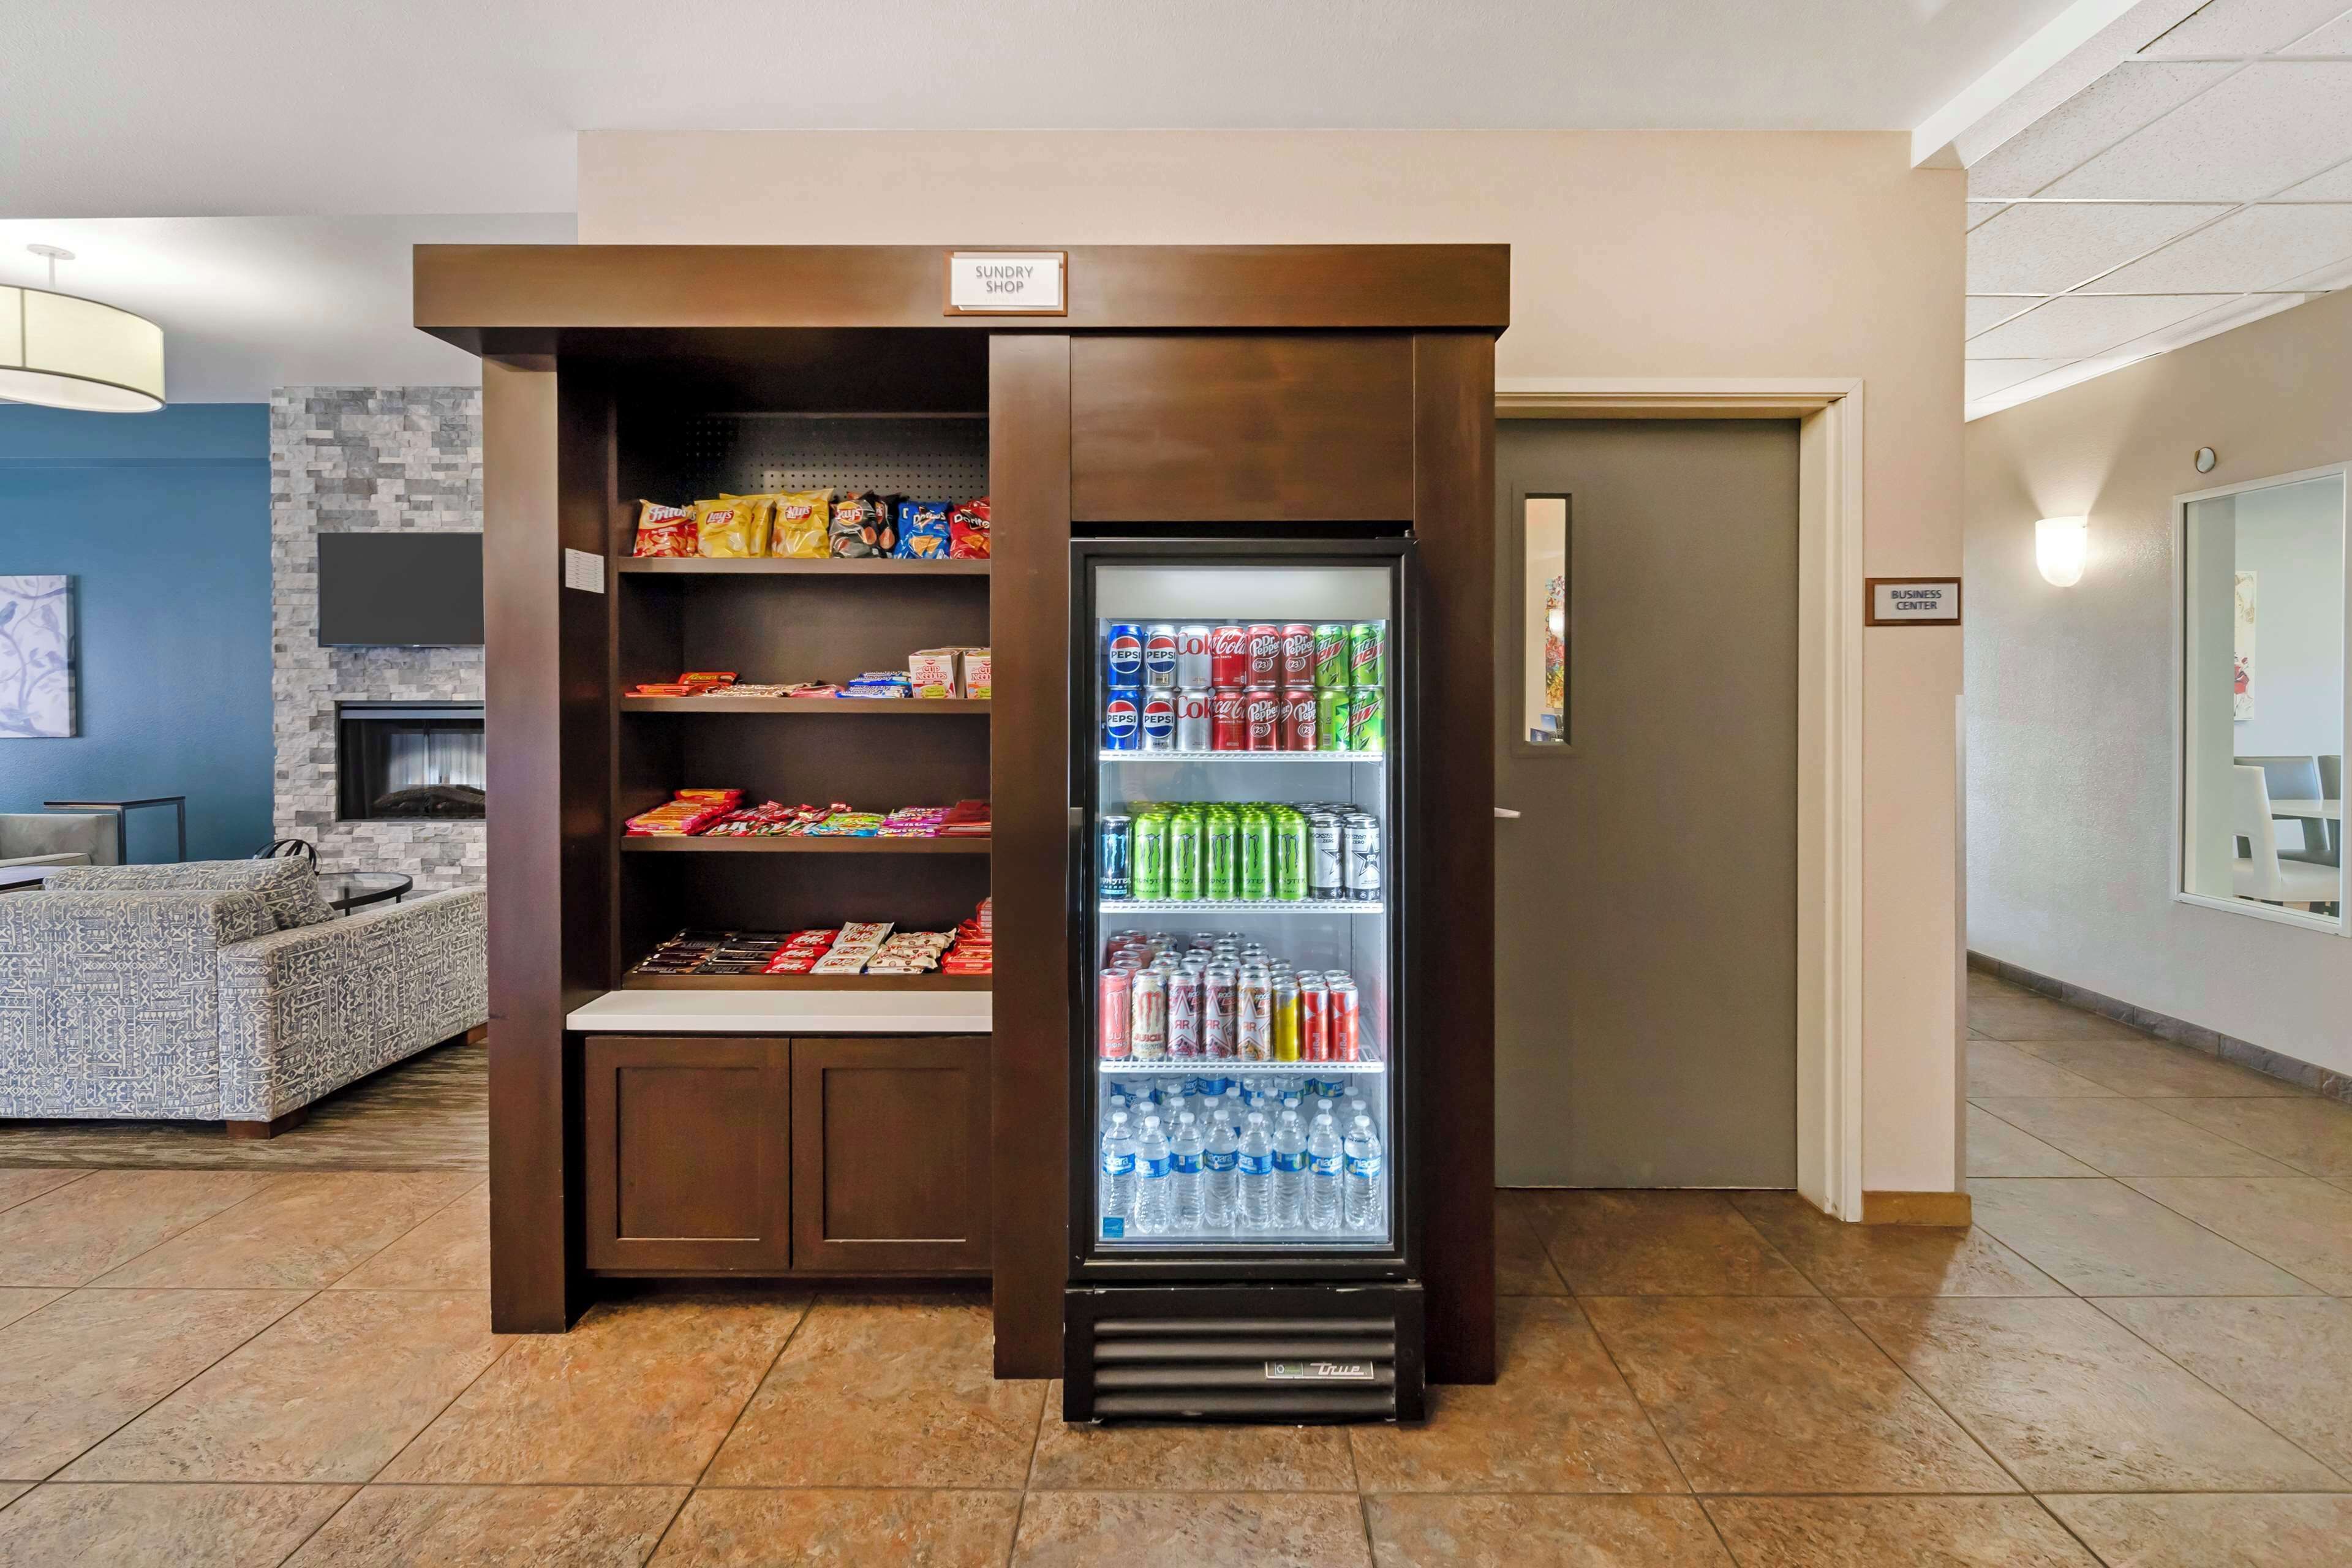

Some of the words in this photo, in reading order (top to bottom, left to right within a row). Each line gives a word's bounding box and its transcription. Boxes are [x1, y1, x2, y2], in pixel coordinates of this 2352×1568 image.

[975, 265, 1033, 279] SUNDRY
[986, 281, 1023, 293] SHOP
[954, 513, 990, 529] Dorito
[1891, 590, 1942, 599] BUSINESS
[1896, 601, 1937, 610] CENTER
[1175, 632, 1212, 655] Cok
[1262, 635, 1275, 644] Dr
[1295, 635, 1308, 644] Dr
[1252, 638, 1280, 658] Pepper
[1285, 637, 1314, 657] Pepper
[1111, 650, 1140, 659] PEPSI
[1147, 650, 1176, 659] PEPSI
[916, 672, 948, 680] NOODLES
[1175, 695, 1212, 719] Cok
[1259, 700, 1272, 710] Dr
[1144, 715, 1174, 723] PEPSI
[1310, 1362, 1365, 1376] True
